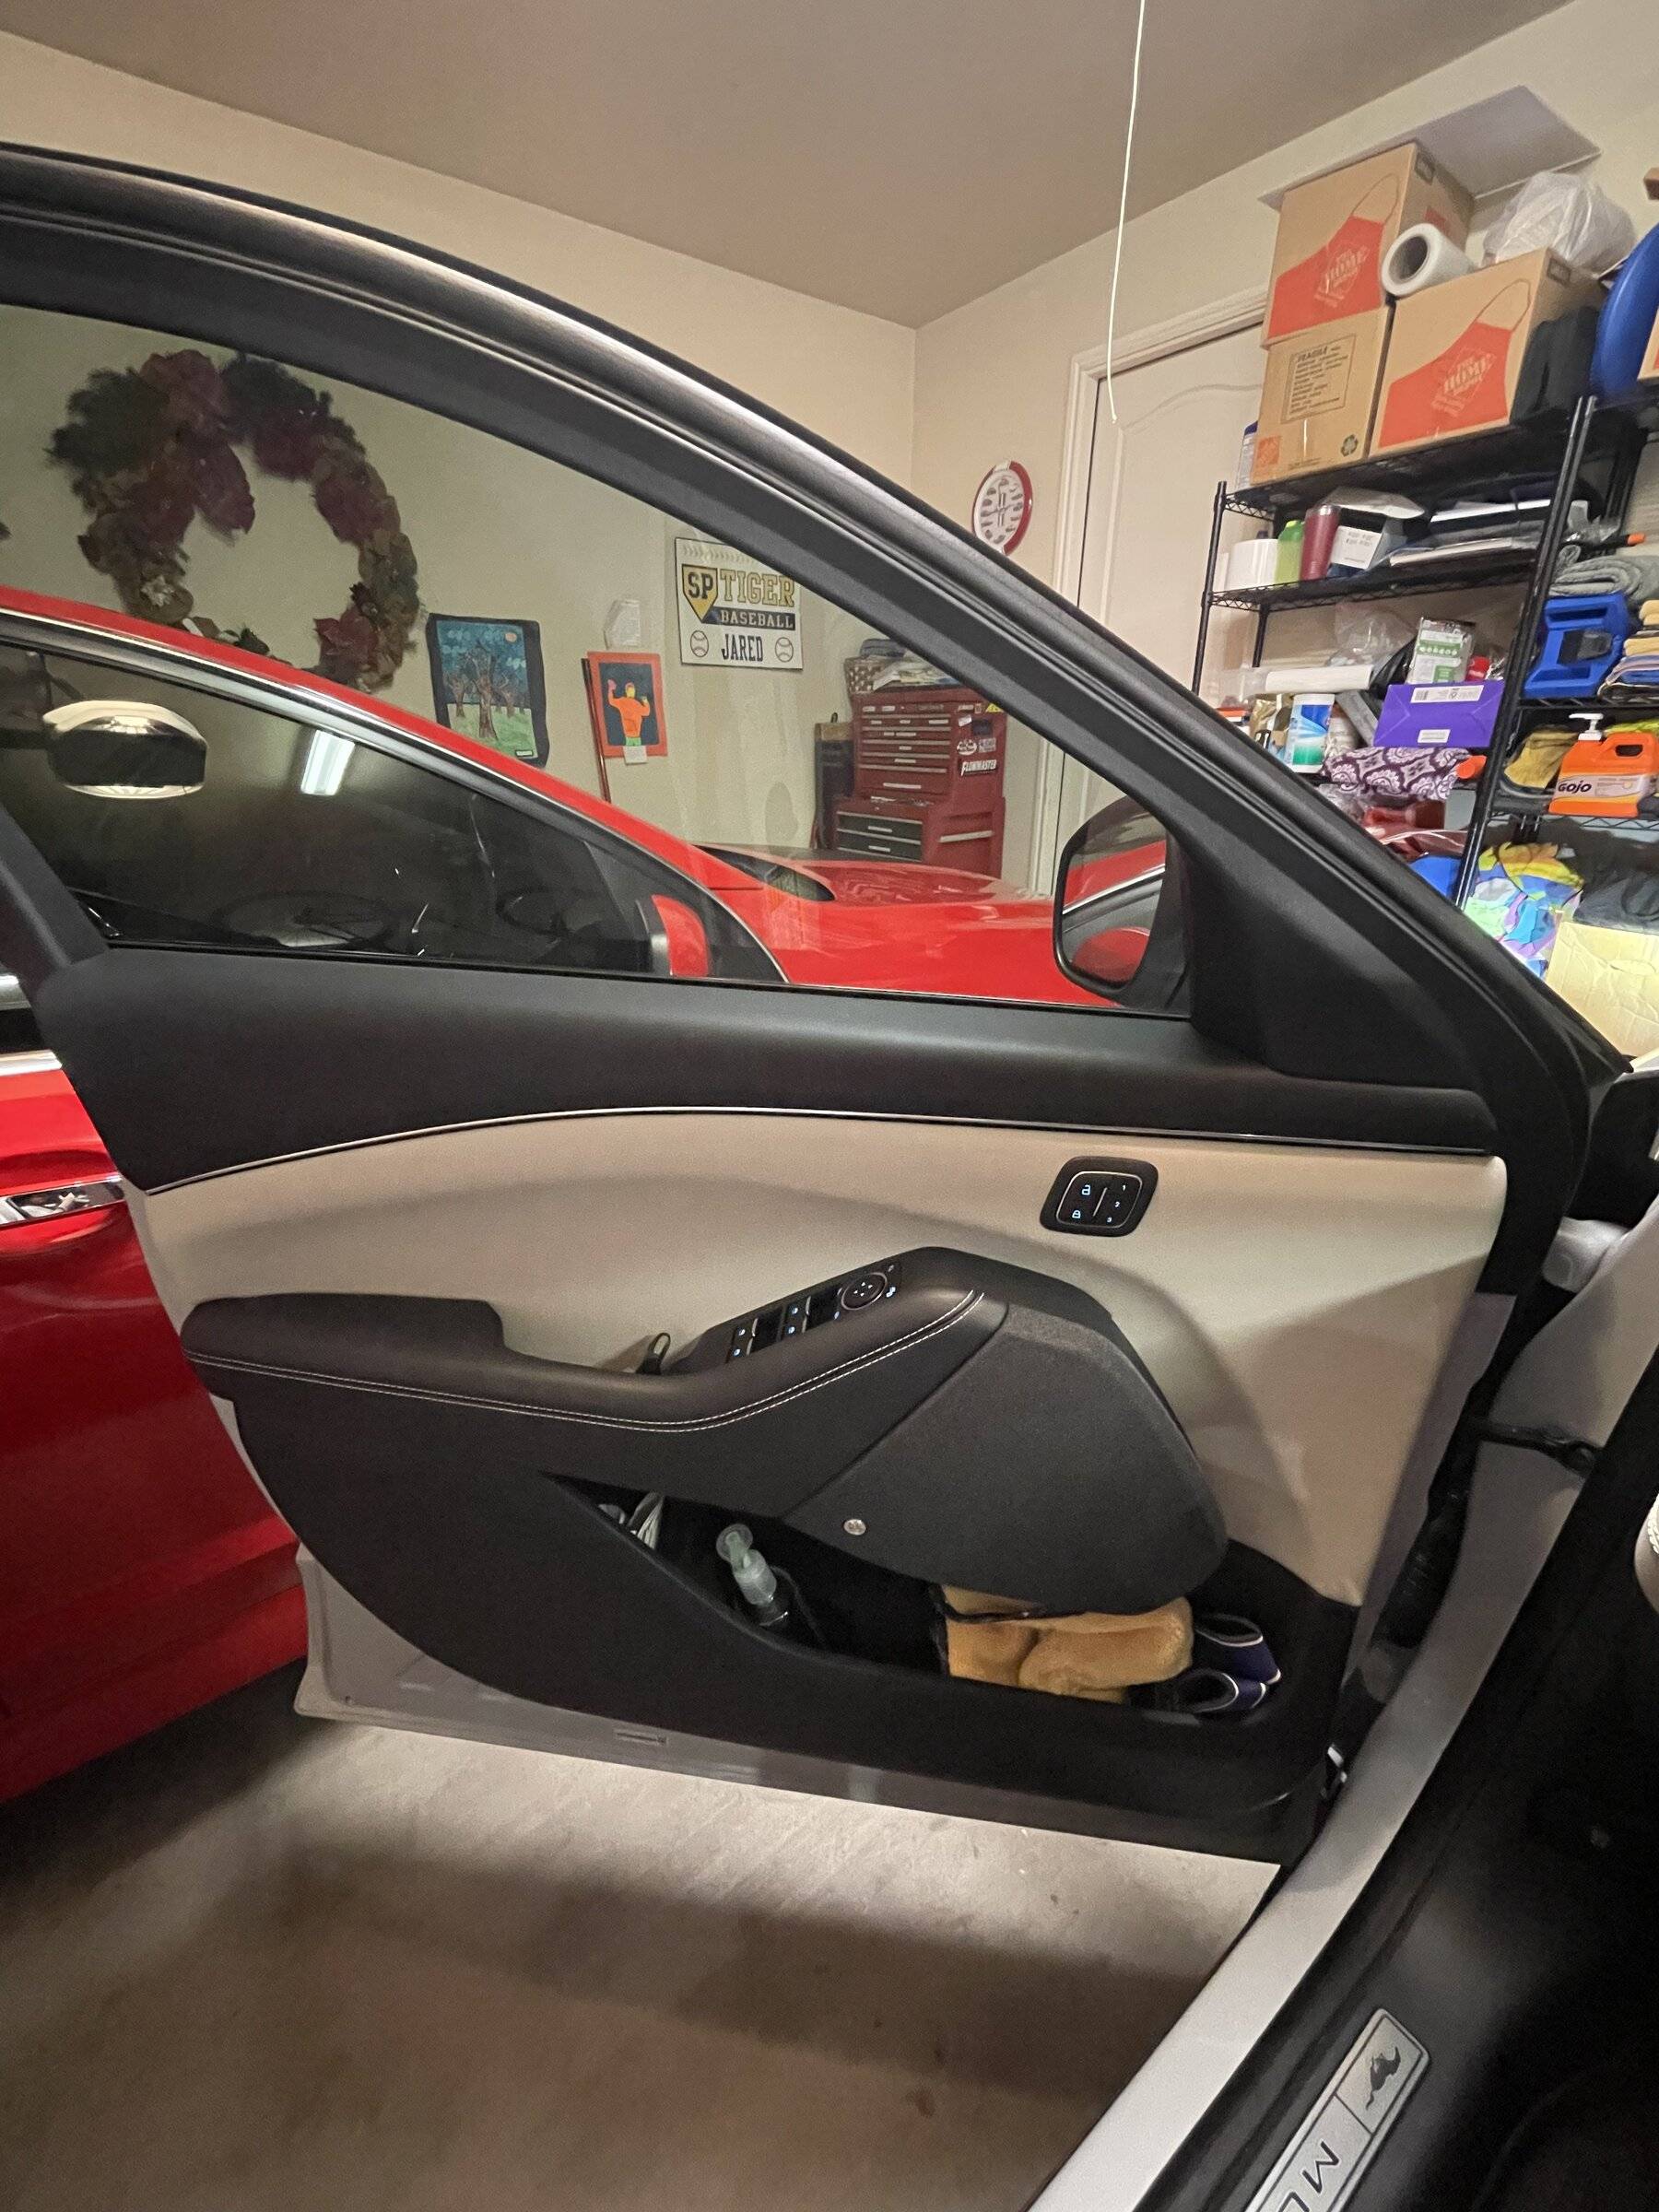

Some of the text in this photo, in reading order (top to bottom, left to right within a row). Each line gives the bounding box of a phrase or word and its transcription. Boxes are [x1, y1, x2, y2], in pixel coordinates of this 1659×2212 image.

[688, 569, 794, 607] SP TIGER
[721, 610, 793, 628] BASEBALL
[721, 634, 763, 662] JARED
